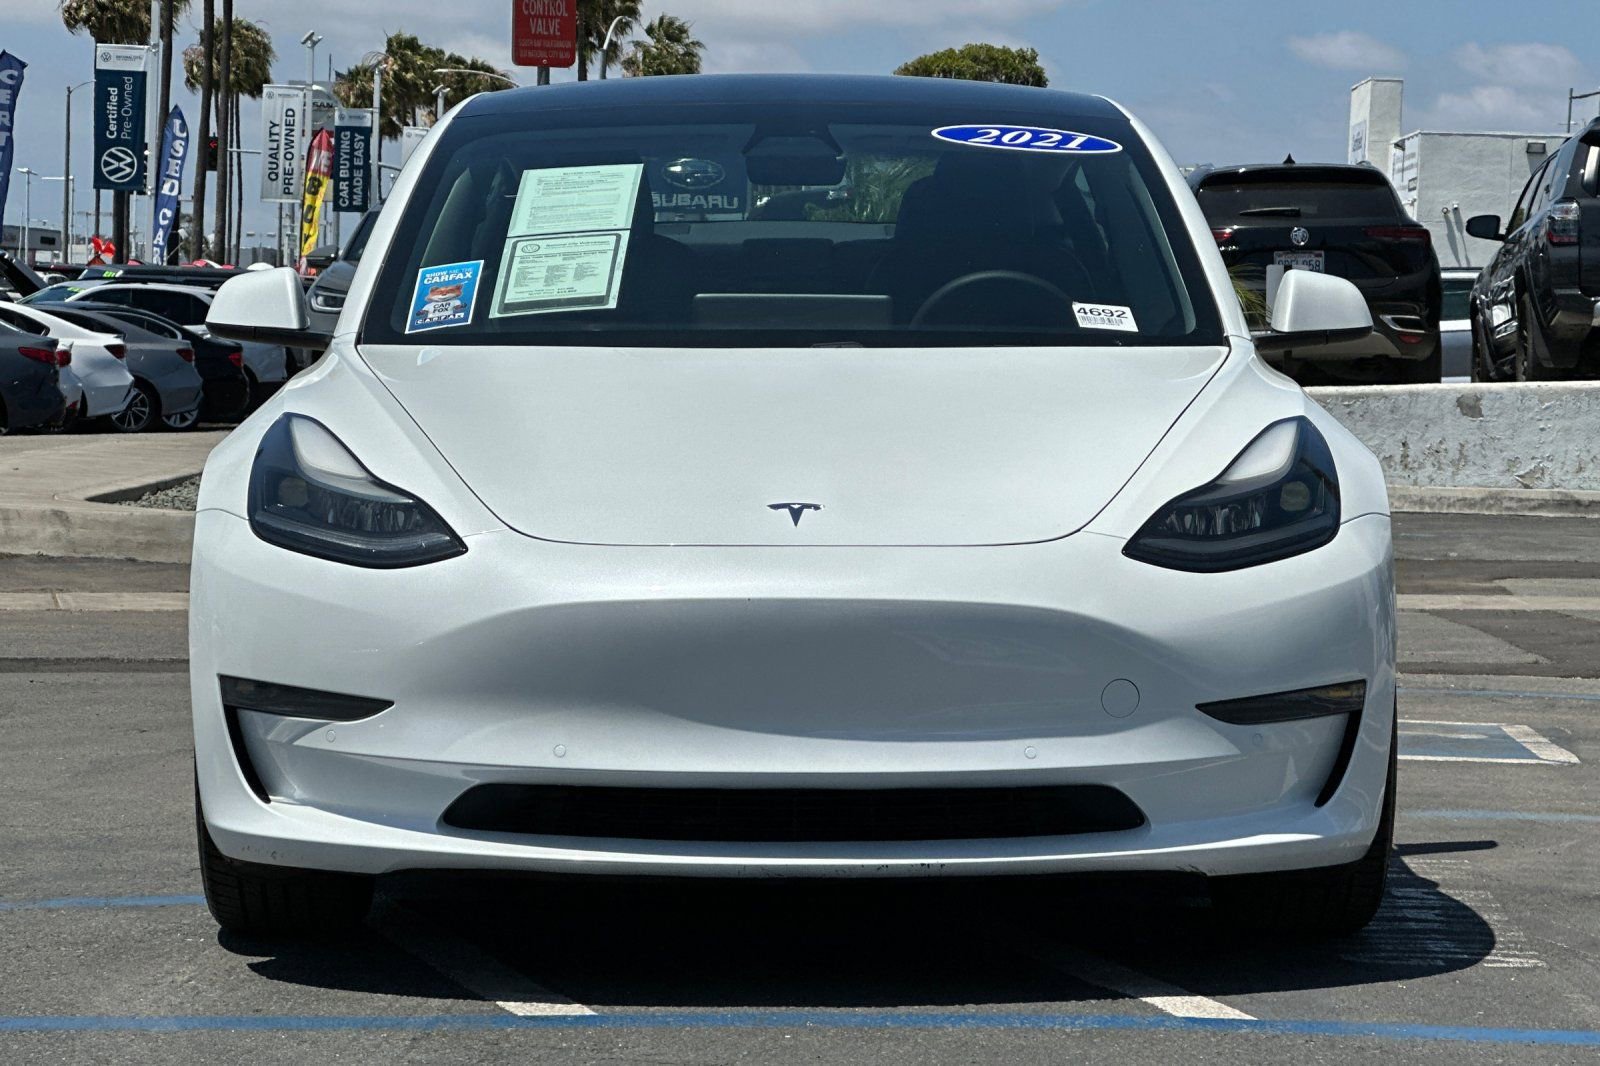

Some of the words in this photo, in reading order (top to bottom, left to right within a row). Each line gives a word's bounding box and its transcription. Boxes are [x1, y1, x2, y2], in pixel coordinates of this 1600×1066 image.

[522, 0, 568, 17] CONTROL
[529, 18, 561, 35] VALVE
[106, 87, 118, 139] Certified
[121, 76, 133, 139] Pre-Owned
[312, 101, 333, 109] SAN
[267, 120, 280, 182] QUALITY
[283, 108, 296, 195] PRE-OWNED
[353, 133, 365, 166] EASY
[968, 128, 1089, 149] 2021
[161, 118, 187, 196] USED
[339, 131, 350, 178] BUYING
[339, 181, 349, 207] CAR
[352, 167, 364, 206] MADE
[651, 191, 738, 209] SUBARU
[423, 272, 473, 285] CARFAX
[425, 270, 448, 278] SHOW
[1076, 307, 1128, 319] 4692
